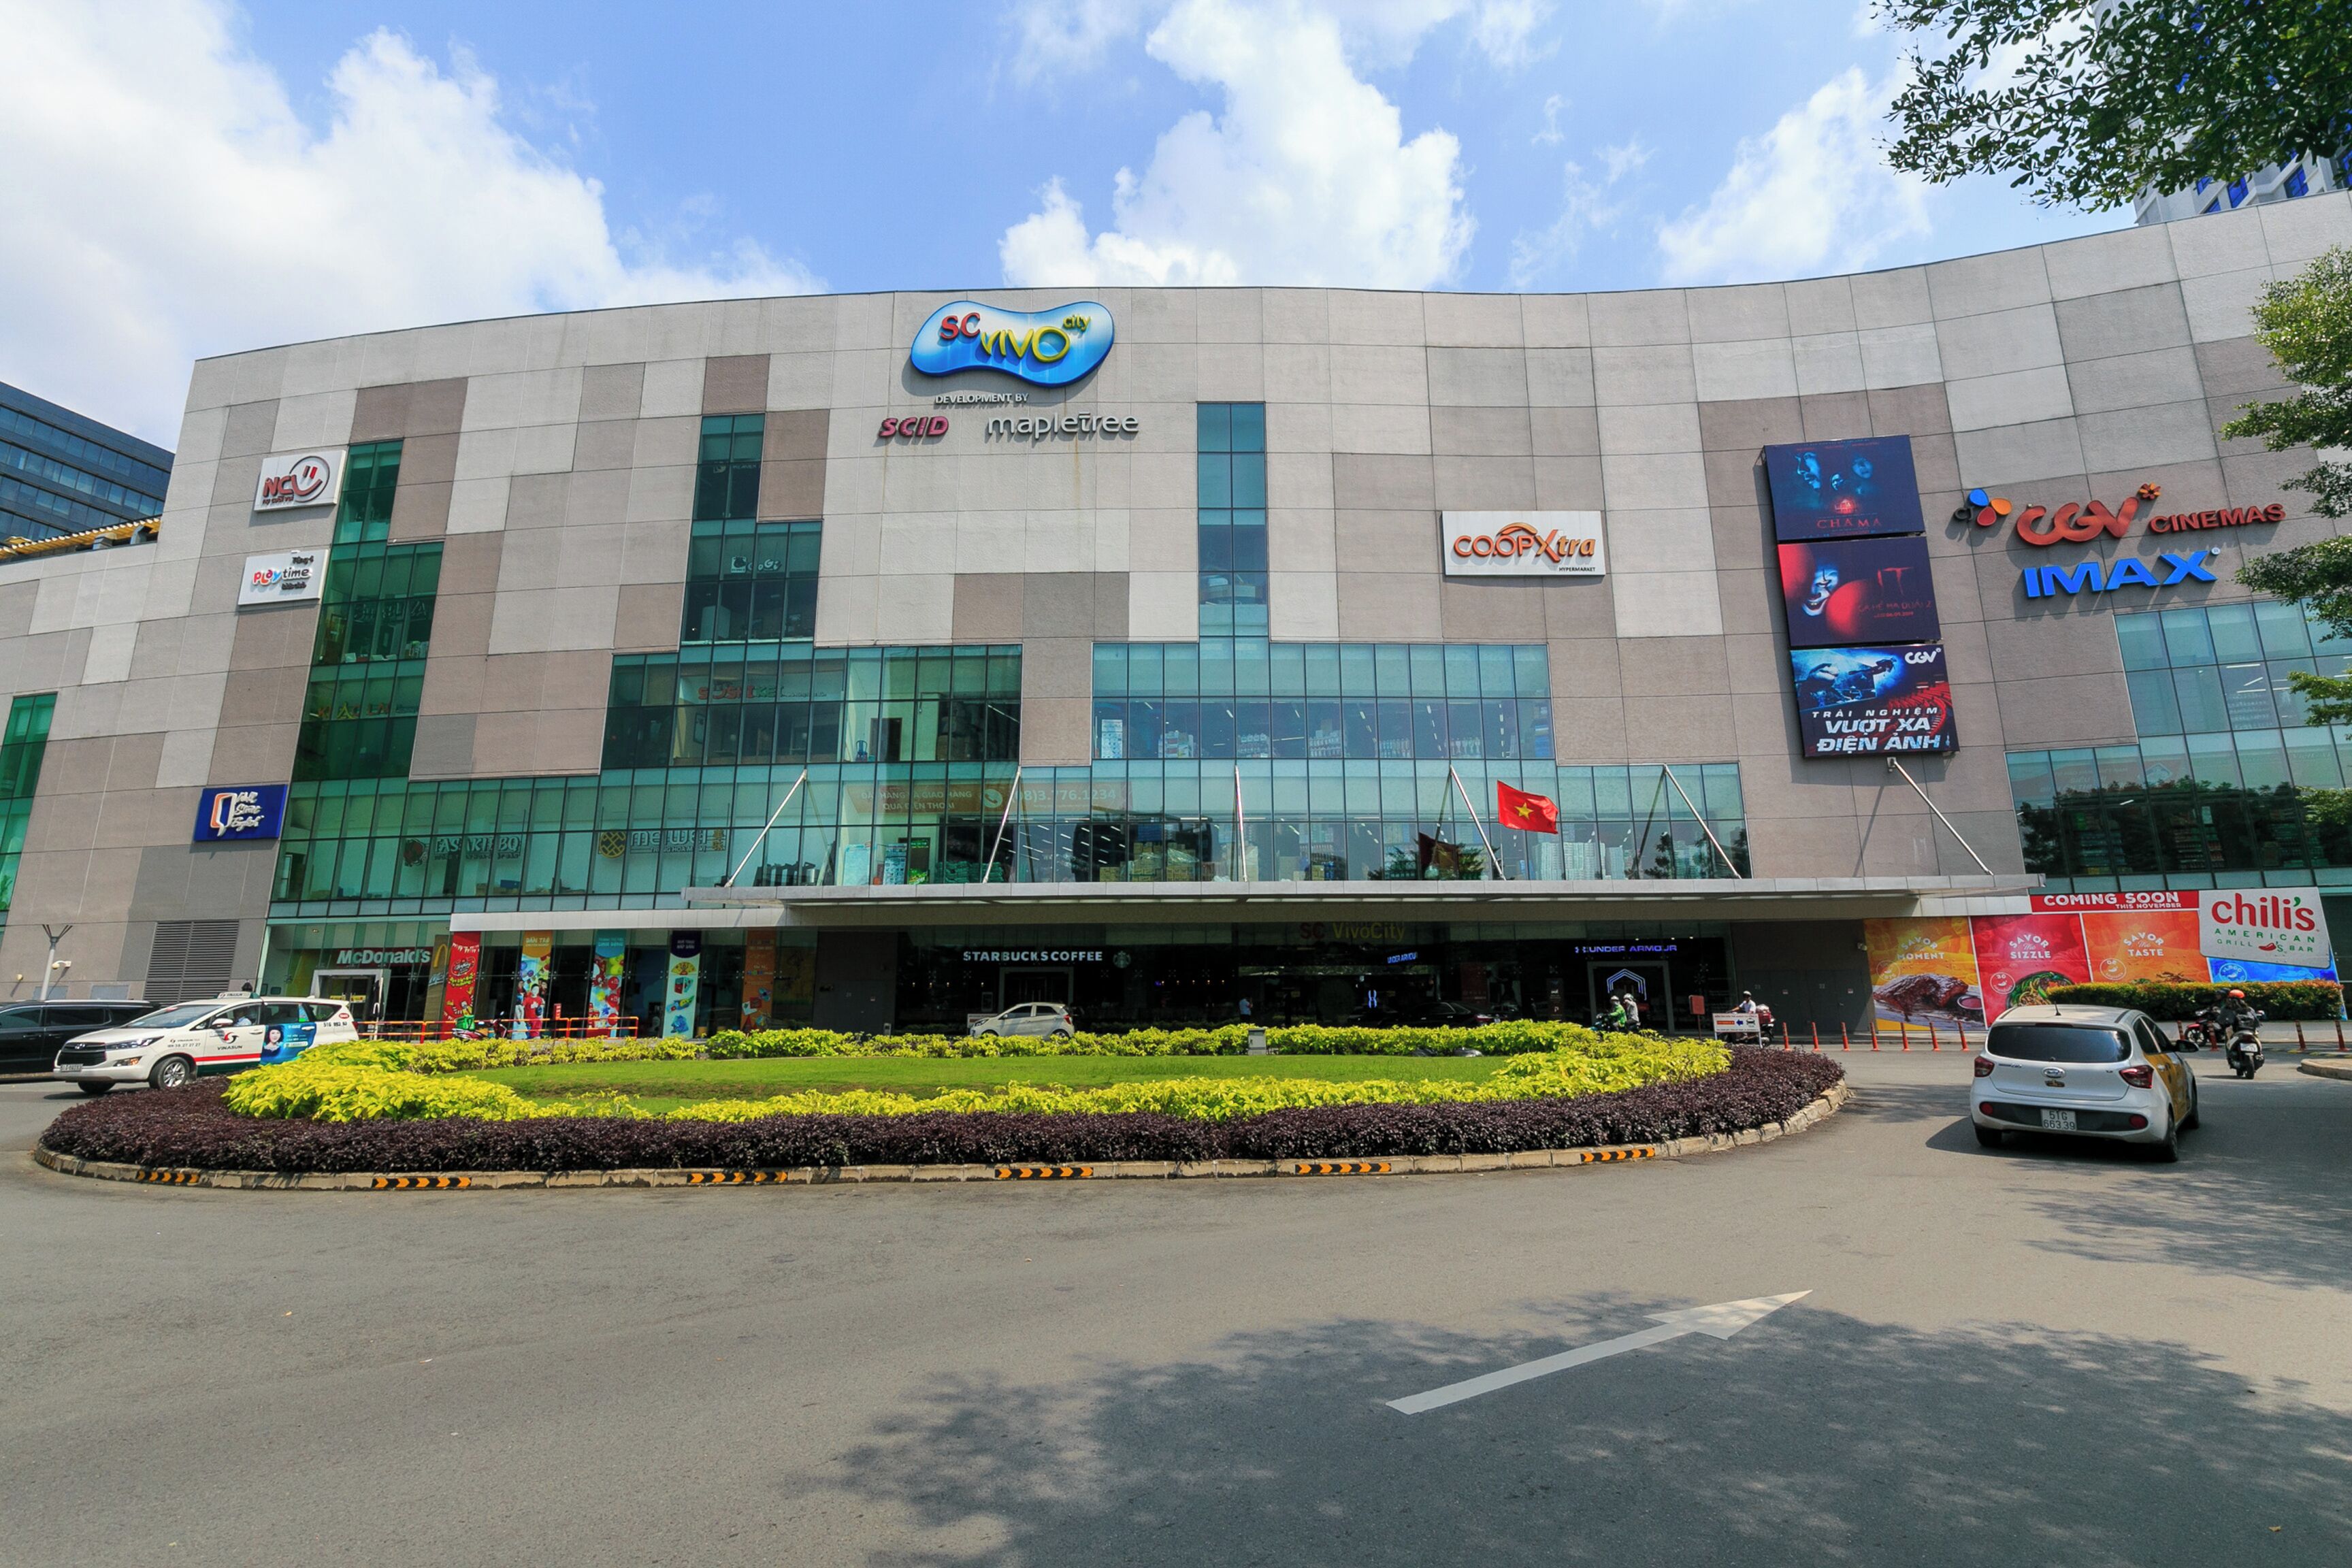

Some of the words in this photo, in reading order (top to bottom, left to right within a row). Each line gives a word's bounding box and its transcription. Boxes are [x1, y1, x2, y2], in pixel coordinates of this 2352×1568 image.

[939, 312, 981, 340] SC
[1063, 314, 1090, 331] city
[935, 393, 1012, 404] DEVELOPMENT
[1015, 393, 1029, 403] BY
[879, 416, 950, 437] SCID
[2015, 497, 2139, 546] CGV
[2149, 503, 2287, 534] CINEMAS
[2023, 550, 2219, 598] IMAX
[1905, 651, 1936, 664] CGV
[1865, 707, 1938, 717] NGHIỆM
[1825, 719, 1890, 736] VƯỢT
[1896, 717, 1931, 732] XA
[1816, 735, 1878, 753] ĐIỆN
[1884, 732, 1940, 750] ẢNH
[2044, 893, 2117, 906] COMING
[2125, 892, 2178, 904] SOON
[2212, 893, 2315, 931] chili's
[1332, 922, 1405, 942] VivoCity
[2123, 932, 2164, 946] SAVOR
[2215, 928, 2315, 943] AMERICAN
[1901, 936, 1938, 950] SAVOR
[2009, 934, 2050, 949] SAVOR
[2217, 938, 2253, 947] GRILL
[336, 949, 431, 964] McDonald's
[963, 951, 1049, 961] STARBUCKS
[1050, 951, 1102, 961] COFFEE
[2010, 951, 2051, 959] SIZZLE
[2049, 1111, 2068, 1120] 51G
[2043, 1120, 2075, 1130] 663.39
